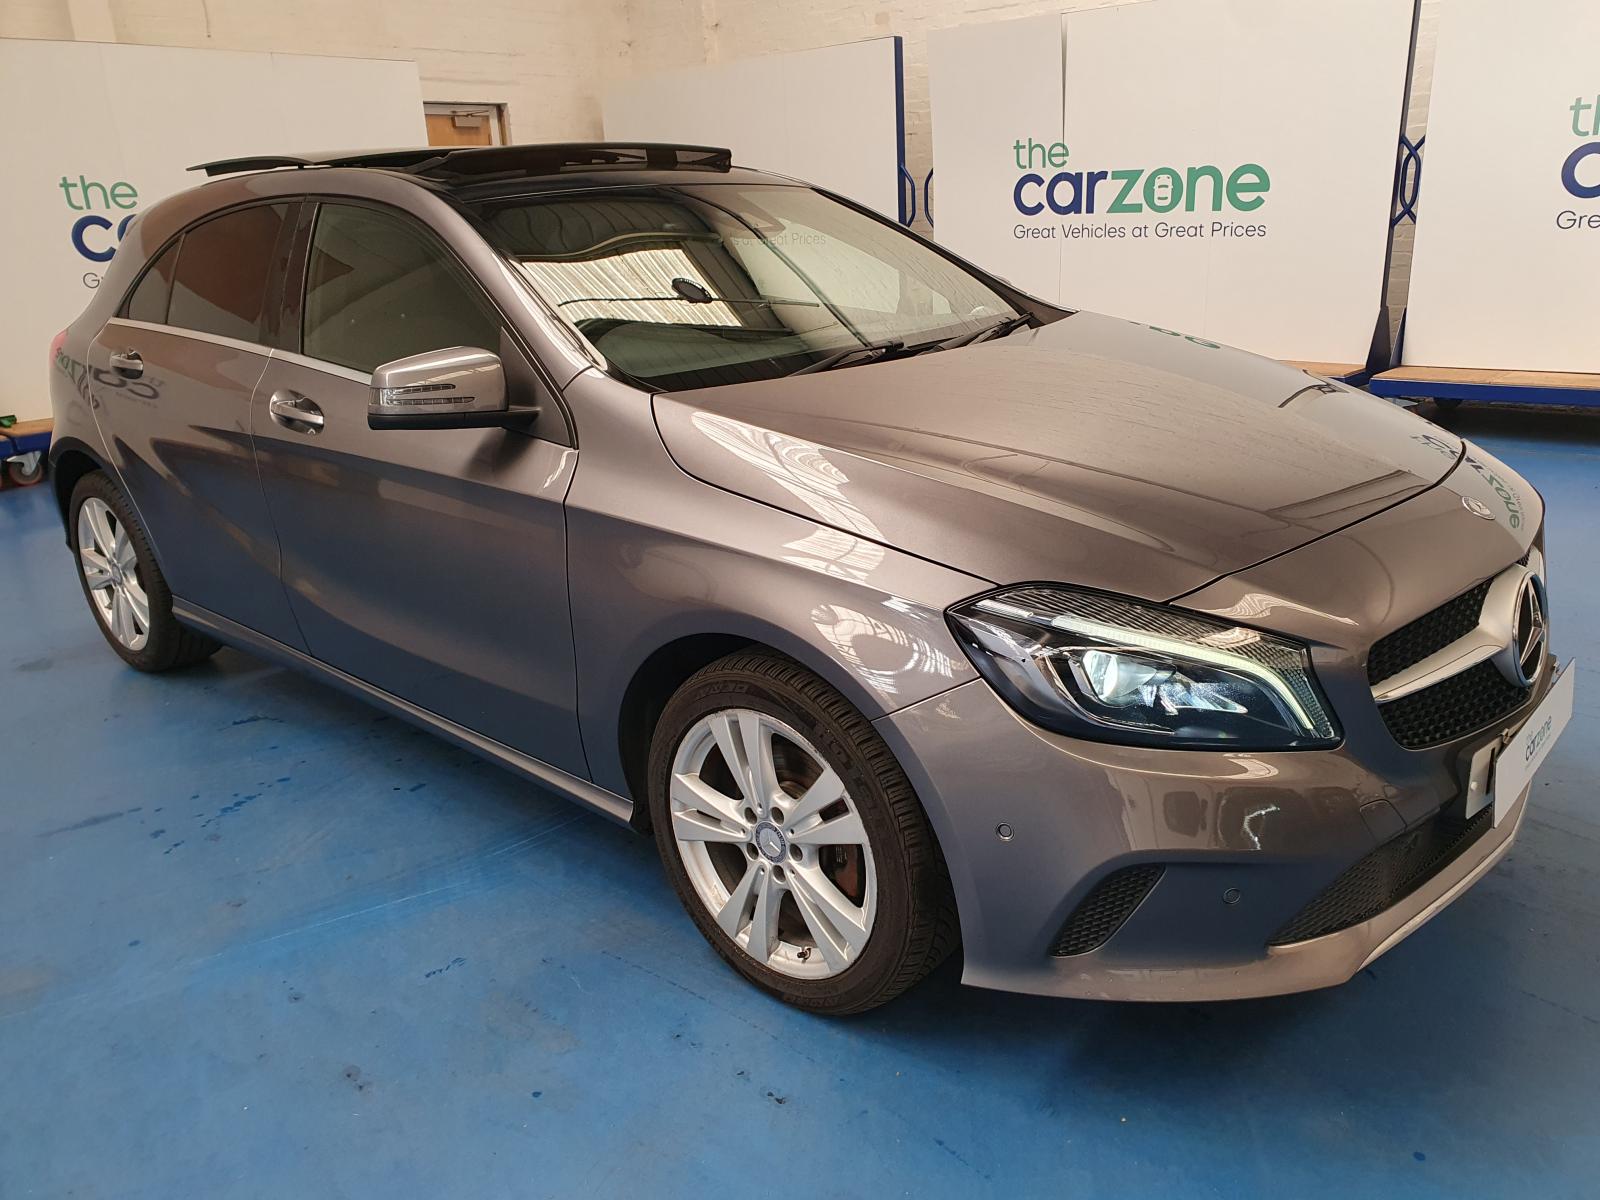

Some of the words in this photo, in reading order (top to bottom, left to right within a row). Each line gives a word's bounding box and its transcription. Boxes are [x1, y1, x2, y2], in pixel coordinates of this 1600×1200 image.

[1013, 137, 1069, 169] the
[59, 175, 138, 210] the
[1013, 163, 1271, 216] carzone
[1013, 224, 1057, 239] Great
[1061, 223, 1127, 239] Vehicles
[1131, 223, 1149, 238] at
[1154, 221, 1205, 238] Great
[1211, 221, 1267, 238] Prices
